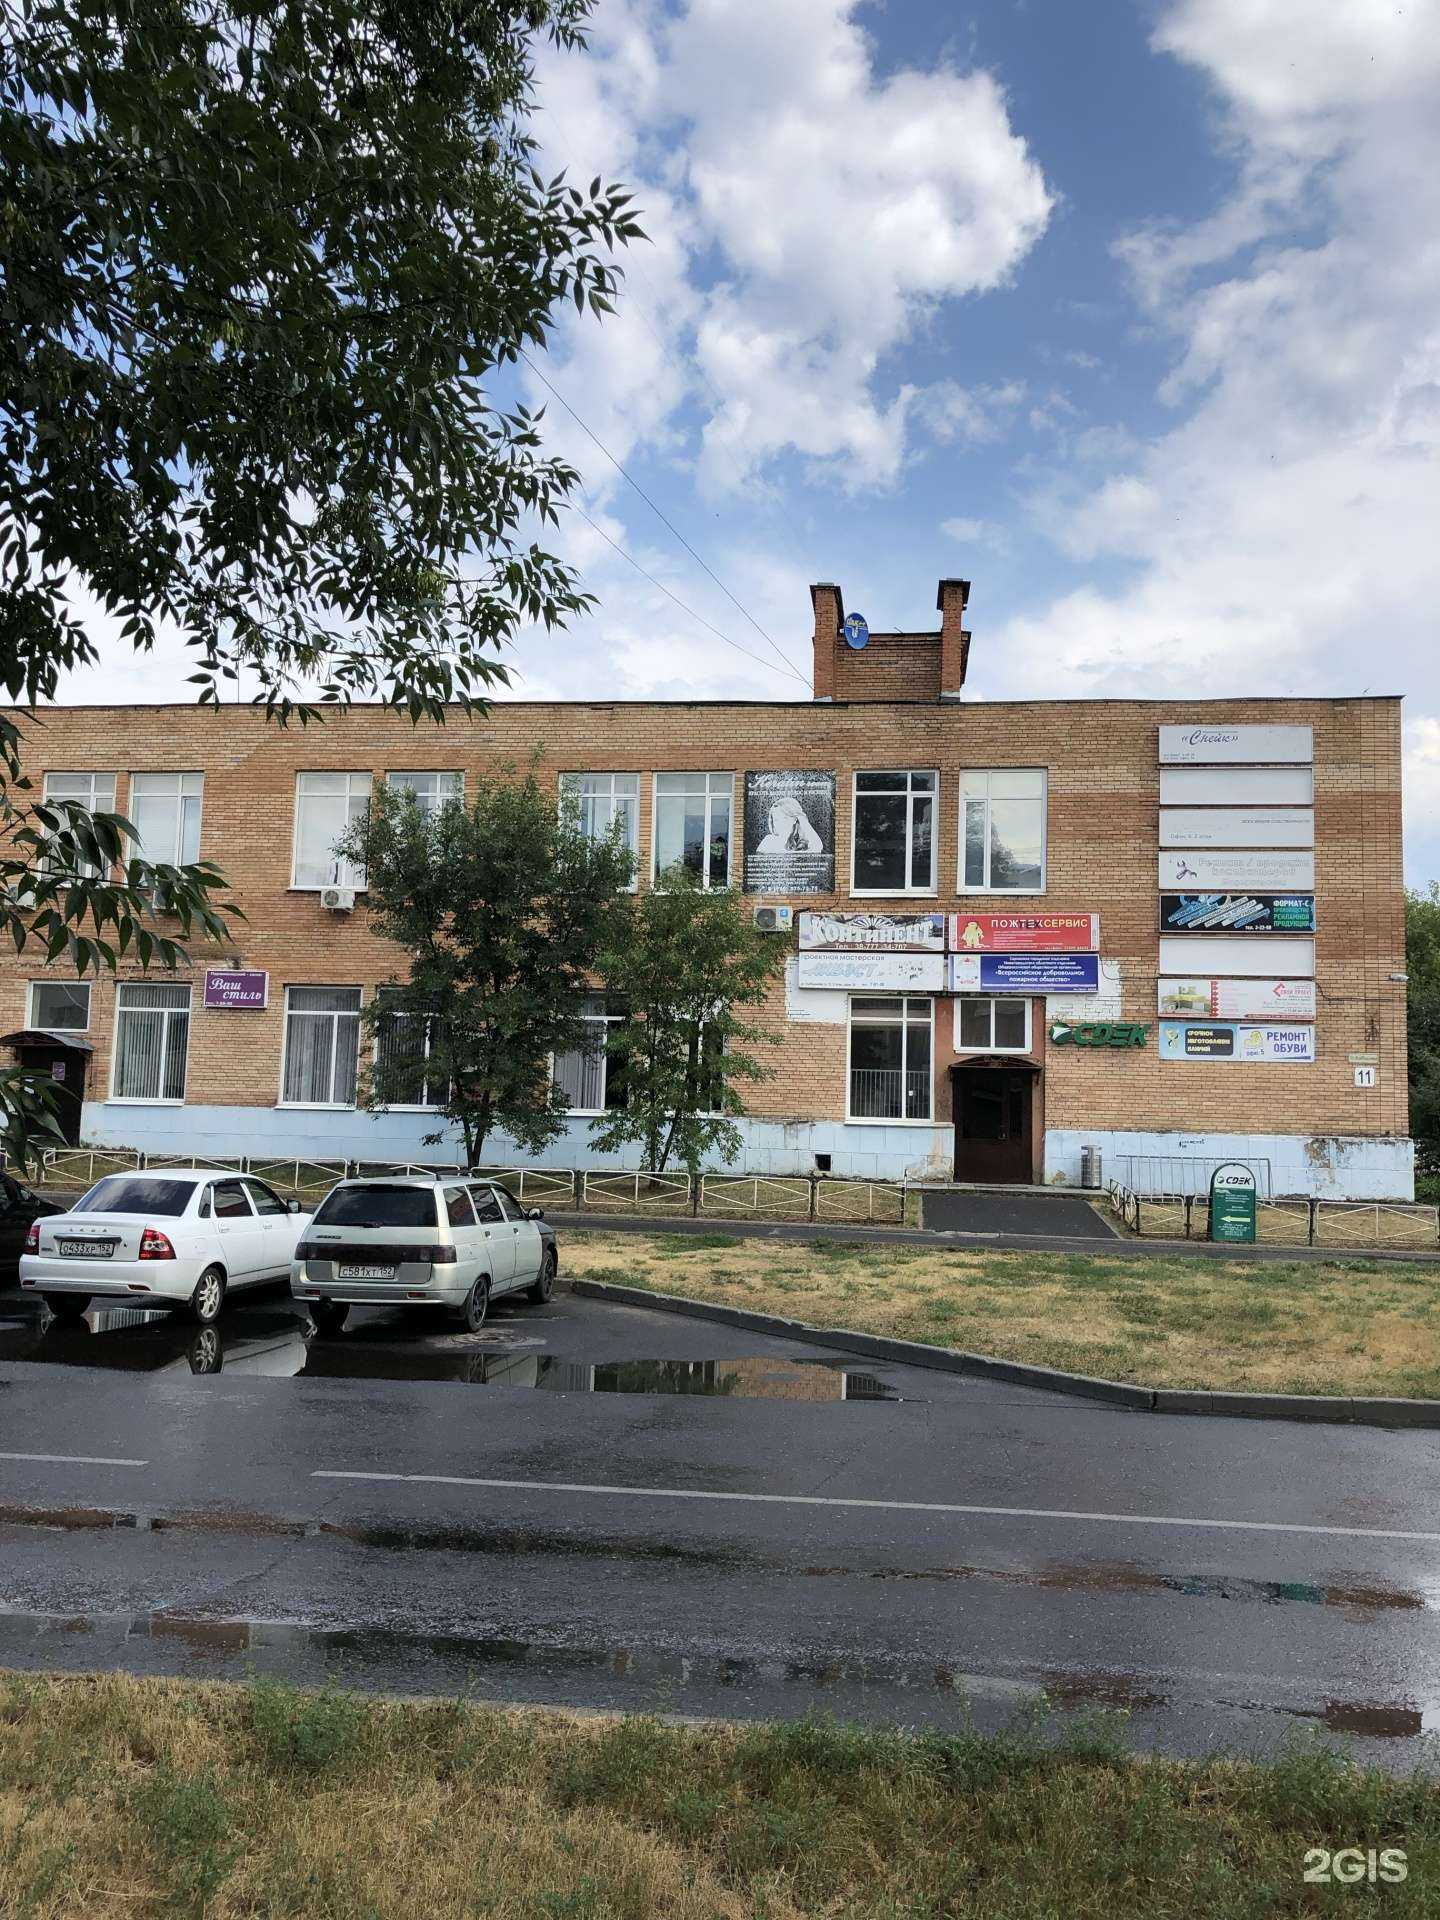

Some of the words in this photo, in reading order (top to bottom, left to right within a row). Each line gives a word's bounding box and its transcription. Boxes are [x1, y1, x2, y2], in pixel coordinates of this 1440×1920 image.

[810, 916, 934, 943] КОНТИНЕНТ
[209, 978, 241, 989] Ваш
[223, 991, 262, 1000] стиль
[1267, 1031, 1307, 1042] РЕМОНТ
[1273, 1043, 1307, 1053] ОБУВИ
[1358, 1070, 1371, 1084] 11
[1226, 1176, 1252, 1185] CDEK
